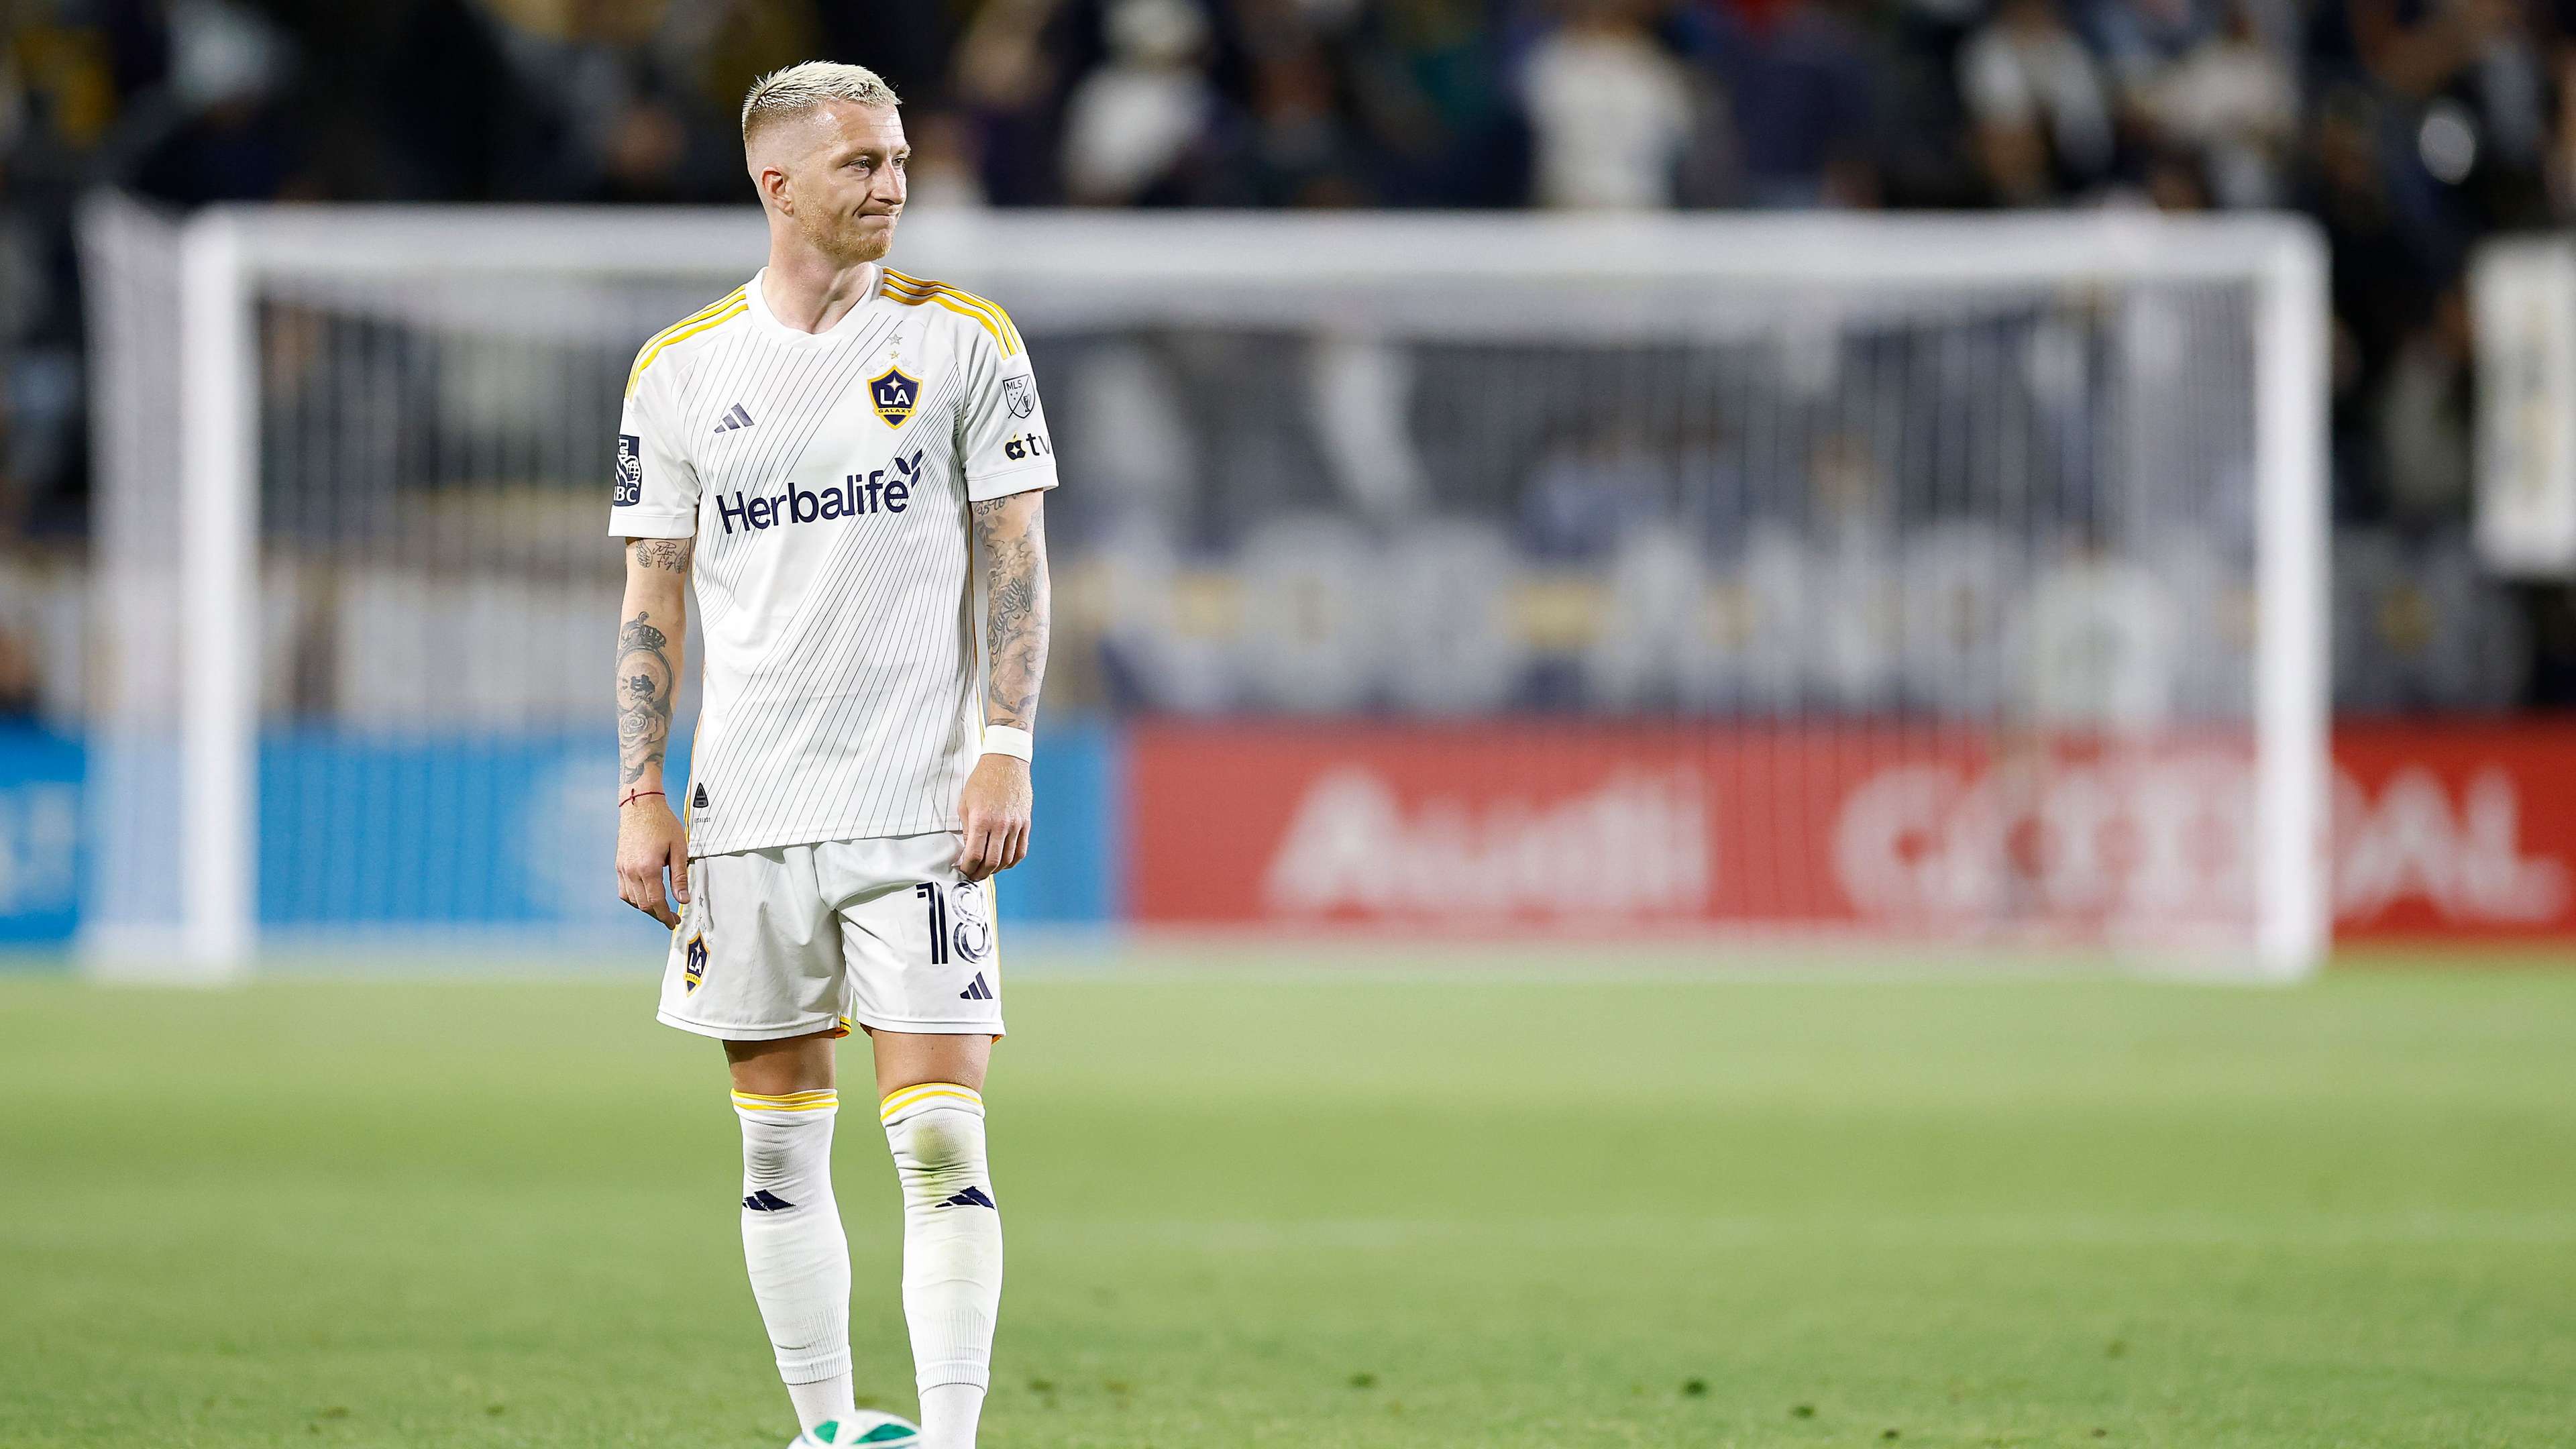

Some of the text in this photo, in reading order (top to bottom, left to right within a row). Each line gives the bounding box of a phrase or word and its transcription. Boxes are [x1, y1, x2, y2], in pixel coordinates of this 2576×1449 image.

[879, 388, 911, 405] LA
[1006, 379, 1023, 391] MLS
[1025, 433, 1051, 456] tv
[715, 470, 909, 535] Herbalife
[1261, 766, 1709, 922] Audi
[916, 879, 992, 965] 18
[688, 952, 702, 975] LA
